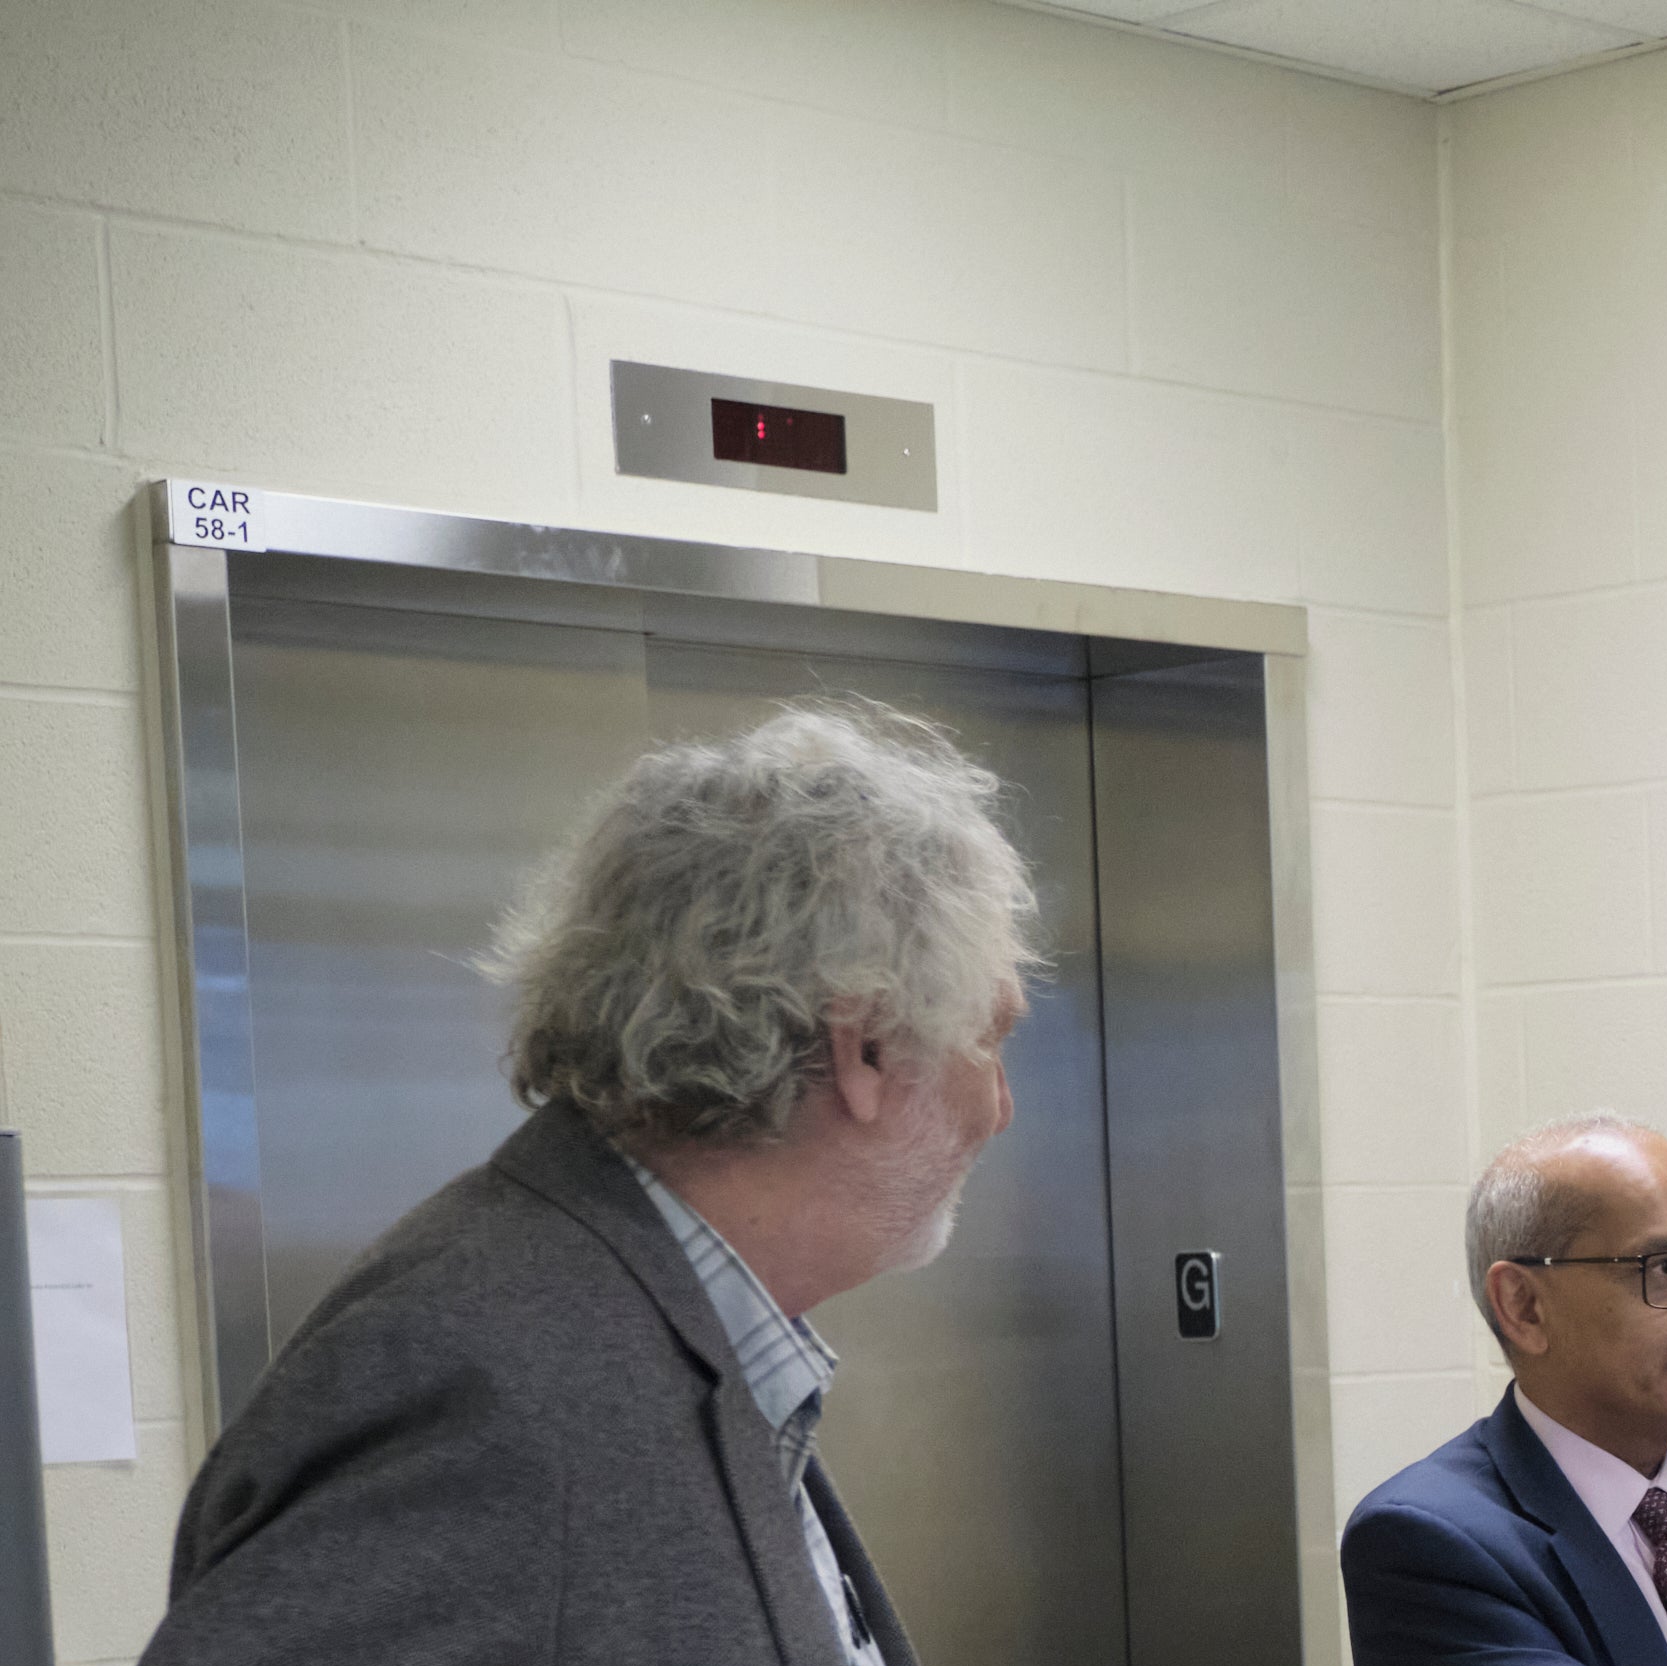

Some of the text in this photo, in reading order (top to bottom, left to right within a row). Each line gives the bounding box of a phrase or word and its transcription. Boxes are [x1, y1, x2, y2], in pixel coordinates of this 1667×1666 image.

[188, 487, 250, 514] CAR
[195, 517, 248, 543] 58-1
[1181, 1259, 1211, 1311] G
